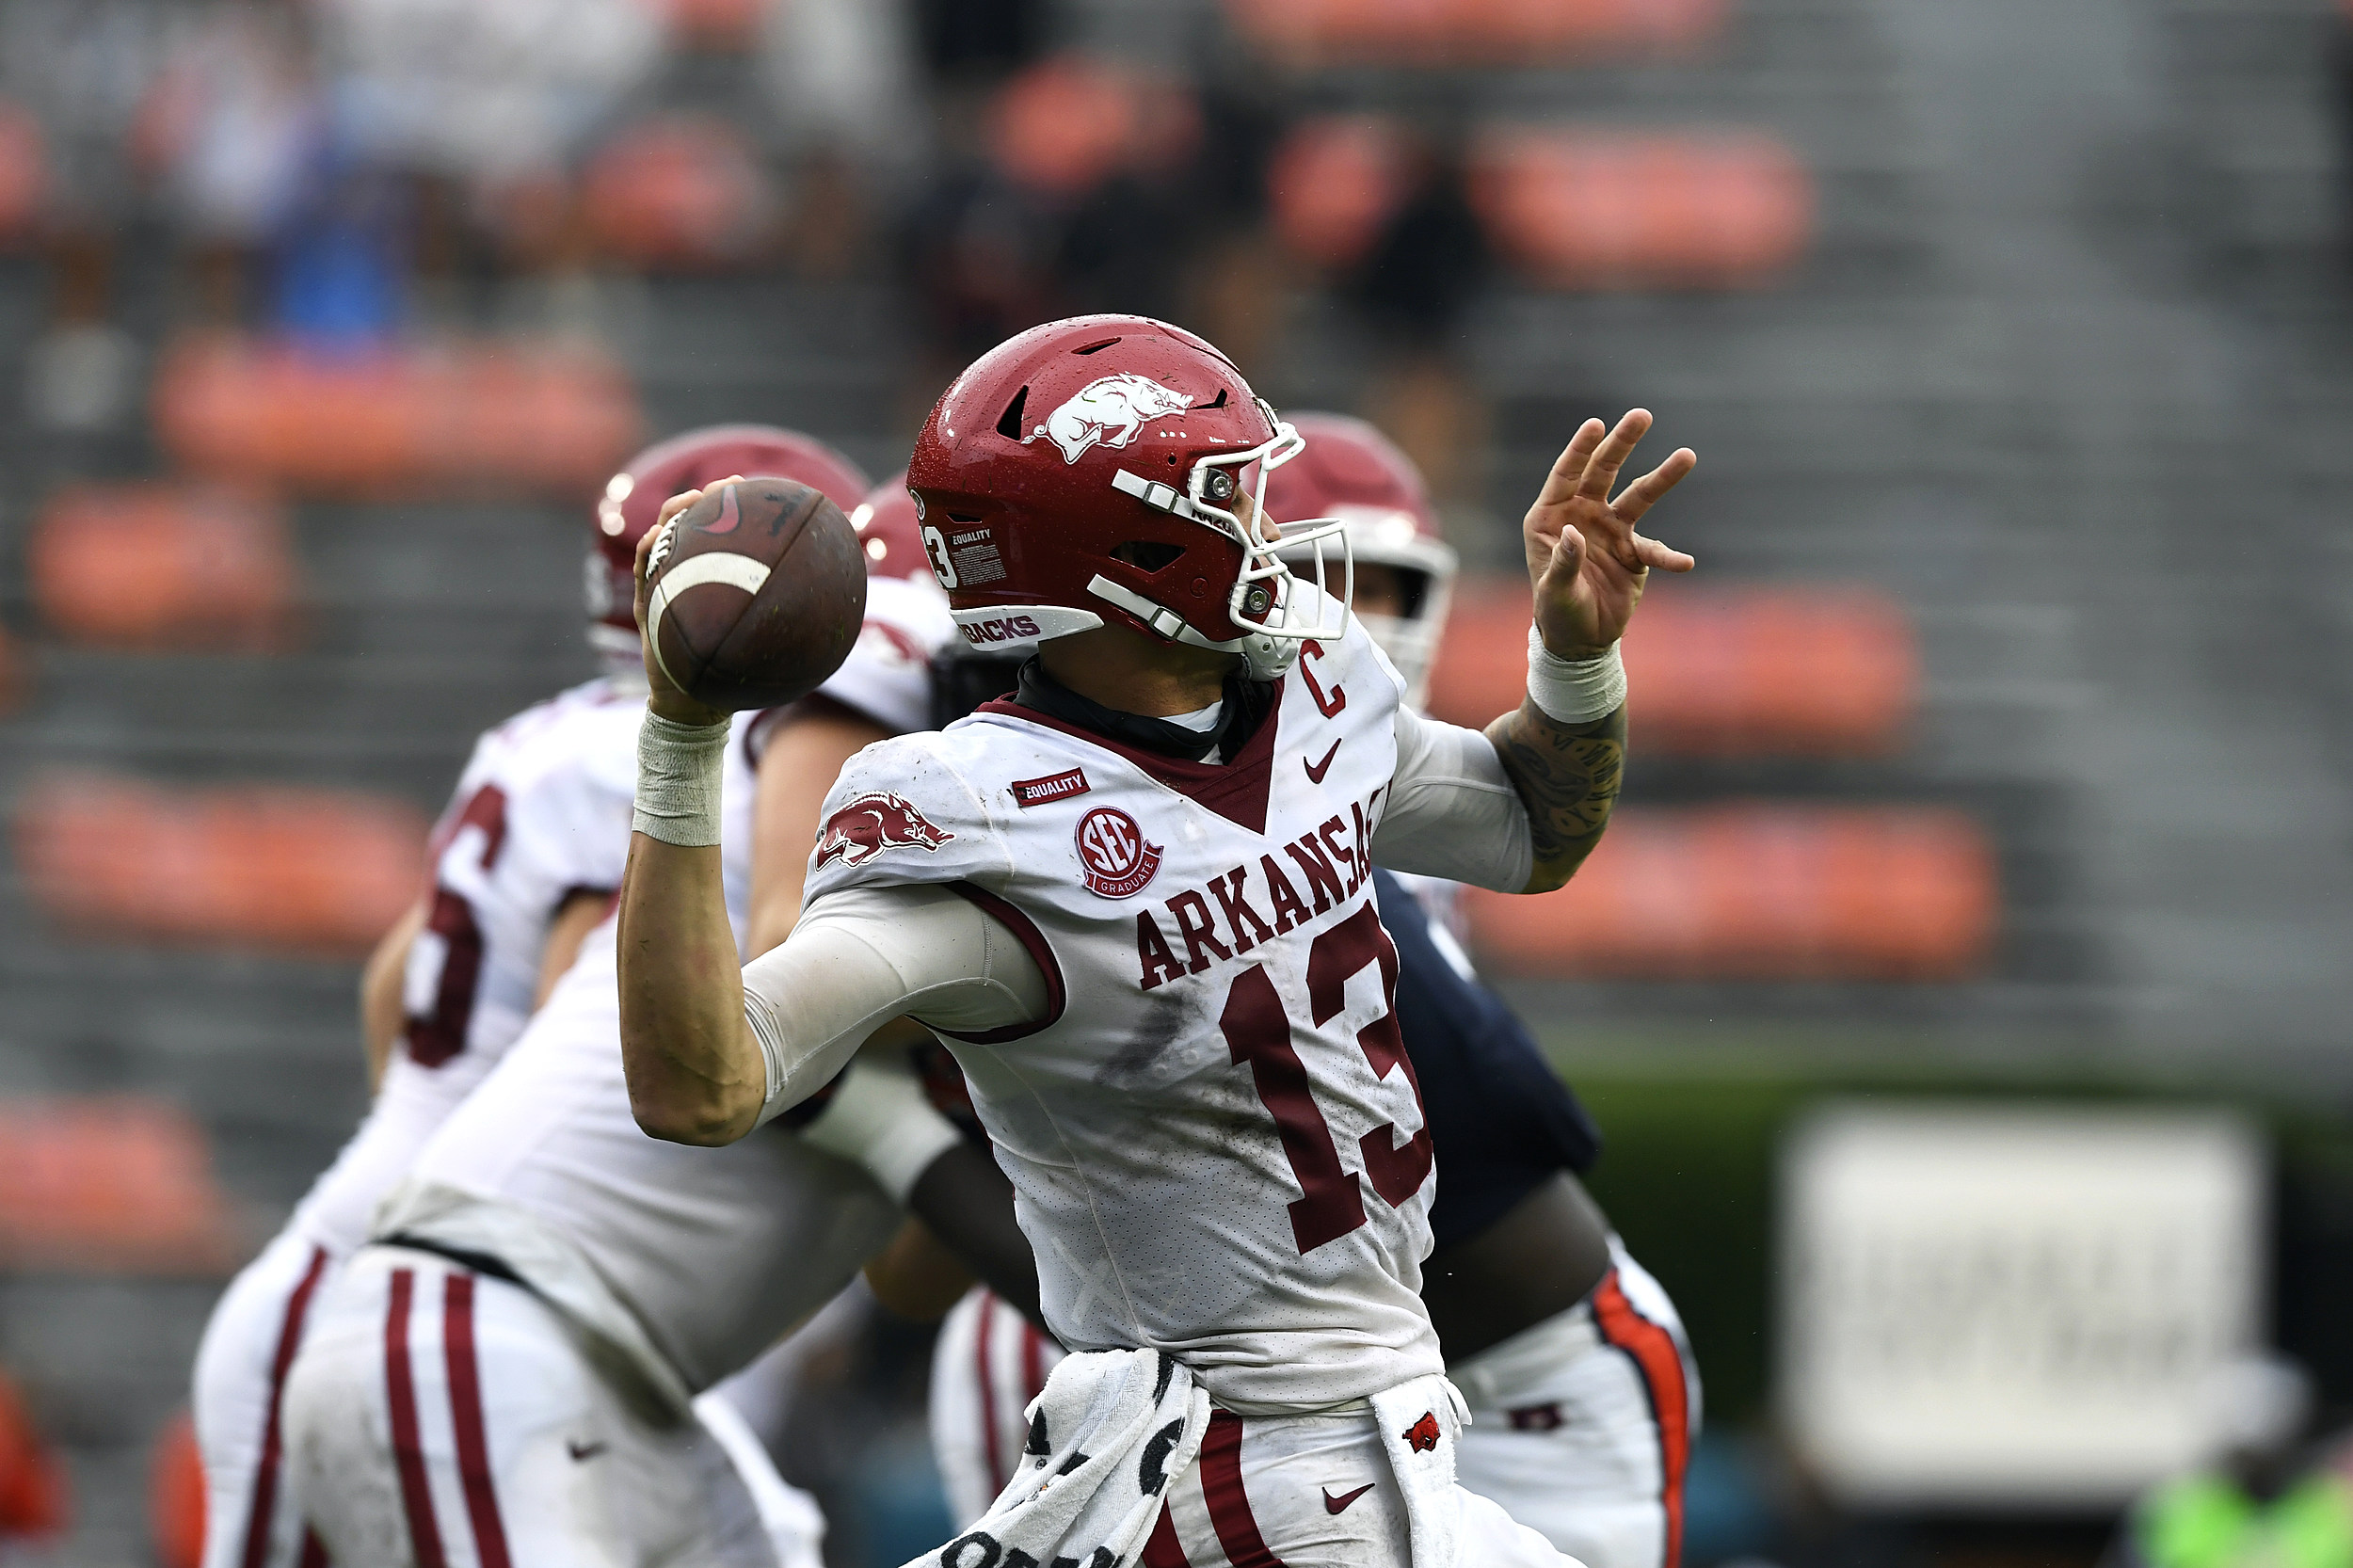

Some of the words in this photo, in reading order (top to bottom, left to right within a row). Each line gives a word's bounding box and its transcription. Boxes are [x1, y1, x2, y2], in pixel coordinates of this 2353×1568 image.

[952, 528, 991, 546] EQUALITY
[960, 615, 1041, 644] BACKS
[1299, 638, 1346, 719] C
[1026, 774, 1083, 800] EQUALITY
[1083, 813, 1136, 873] SEC
[1100, 860, 1155, 894] GRADUATE
[1219, 898, 1433, 1256] 13
